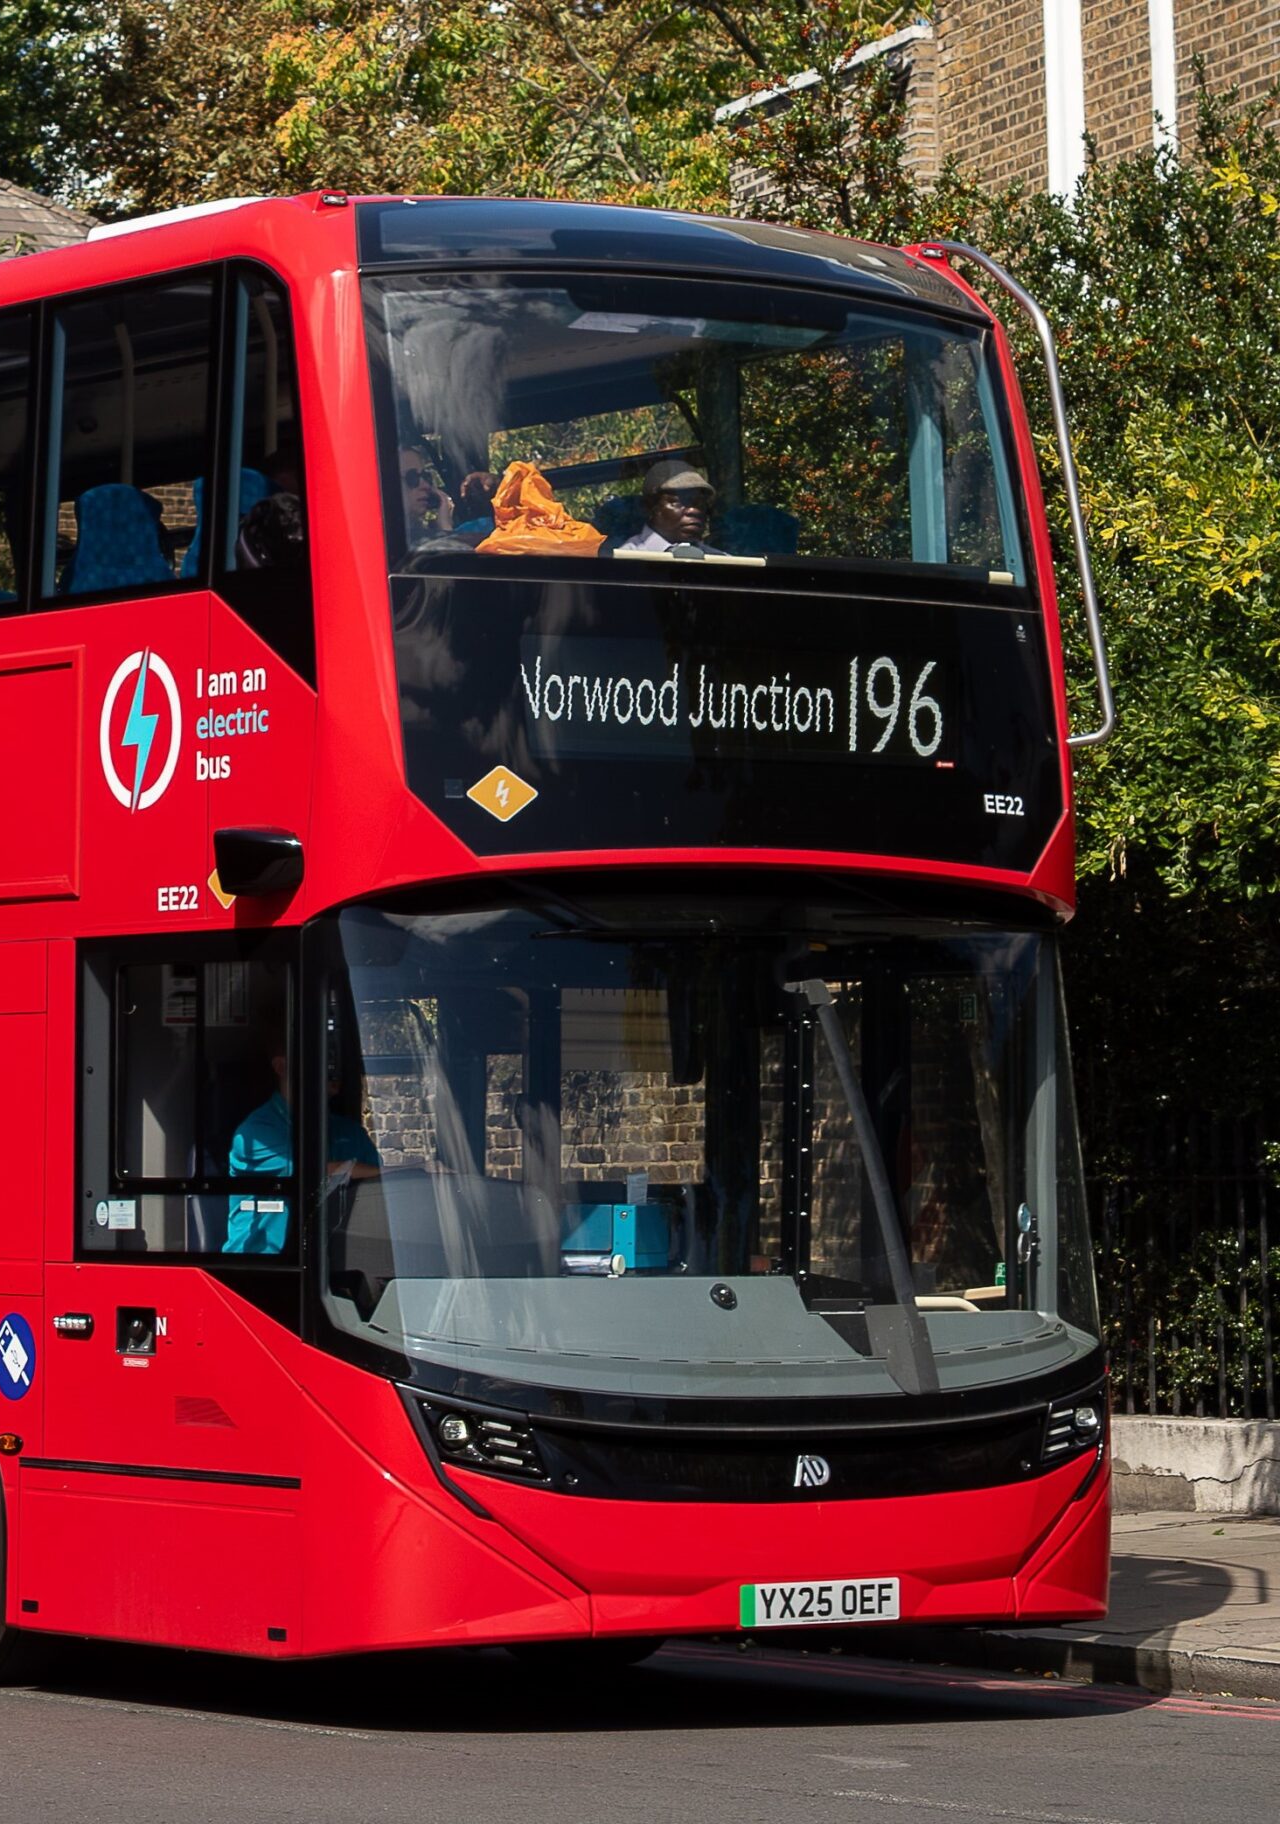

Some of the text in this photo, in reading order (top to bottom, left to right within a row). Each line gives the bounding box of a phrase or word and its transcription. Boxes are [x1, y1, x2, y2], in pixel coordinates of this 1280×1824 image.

[196, 667, 266, 698] I am an
[195, 703, 269, 739] electric
[689, 665, 834, 733] Junction
[849, 656, 943, 756] 196
[195, 751, 231, 781] bus
[984, 794, 1025, 816] EE22
[157, 885, 198, 911] EE22
[759, 1583, 893, 1619] YX25 OEF
